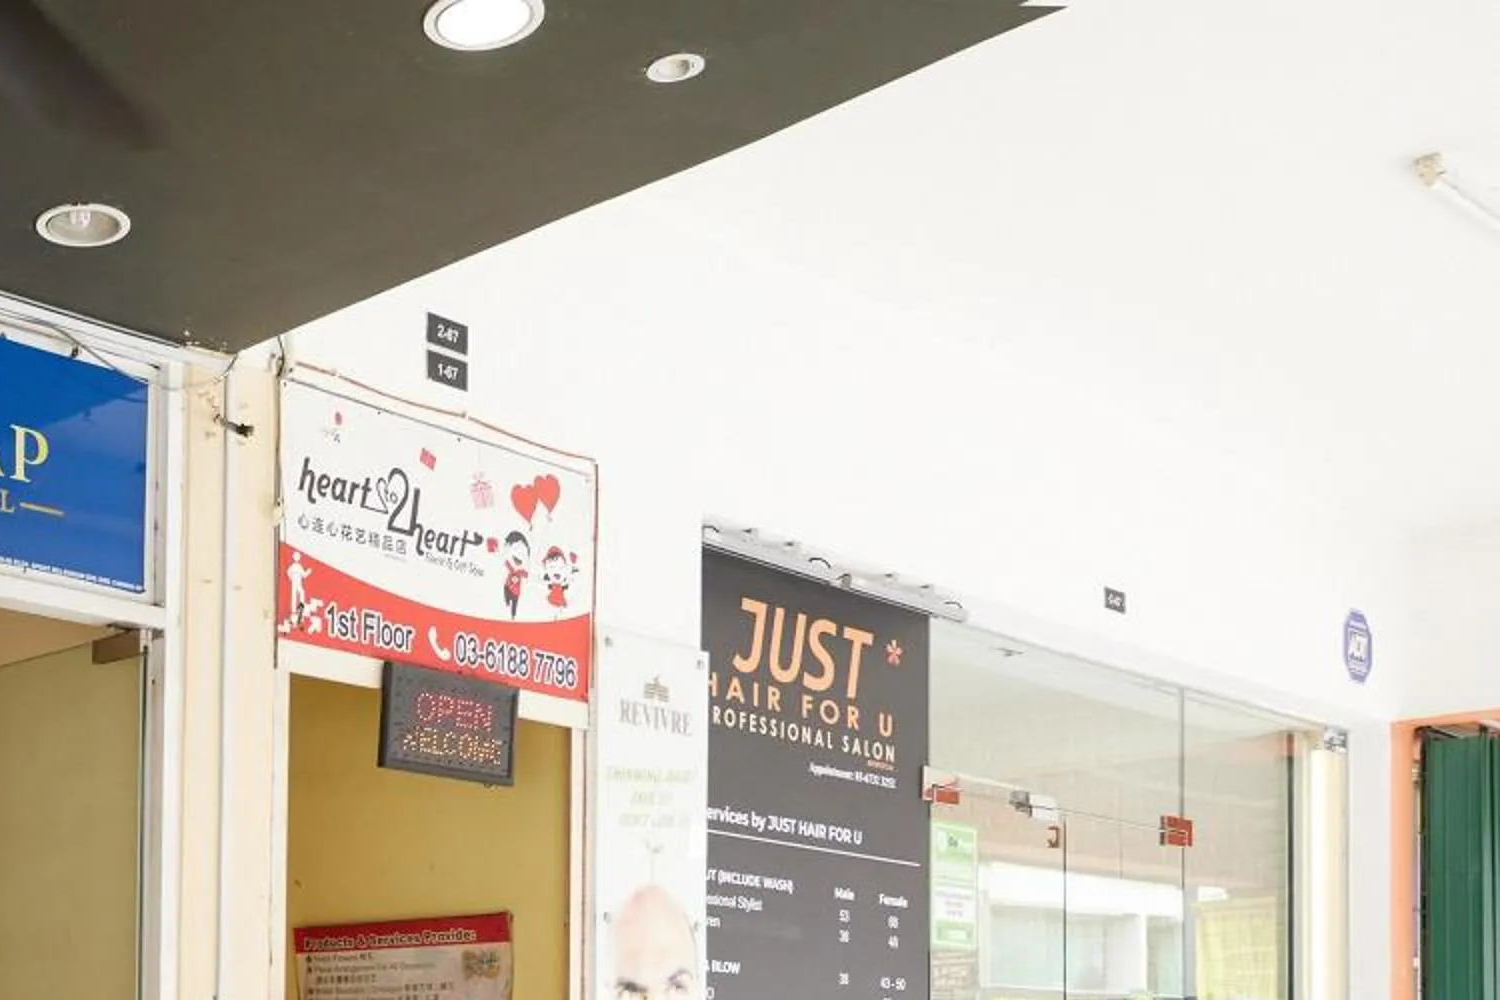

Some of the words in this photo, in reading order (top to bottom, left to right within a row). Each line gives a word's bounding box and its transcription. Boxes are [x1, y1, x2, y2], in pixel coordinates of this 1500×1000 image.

[326, 604, 357, 640] 1st
[362, 611, 415, 652] Floor
[454, 633, 529, 677] 03-6188
[534, 652, 577, 688] 7796
[732, 596, 875, 700] JUST
[416, 691, 493, 732] OPEN
[619, 697, 693, 737] REVIVRE
[802, 695, 860, 731] FOR
[878, 712, 893, 738] U
[712, 705, 833, 750] ROFESSIONAL
[841, 735, 896, 763] SALON
[707, 805, 749, 826] ervices
[751, 811, 766, 833] by
[767, 815, 797, 835] JUST
[798, 819, 827, 840] HAIR
[828, 825, 852, 844] FOR
[854, 831, 863, 846] U
[711, 959, 741, 975] BLOW
